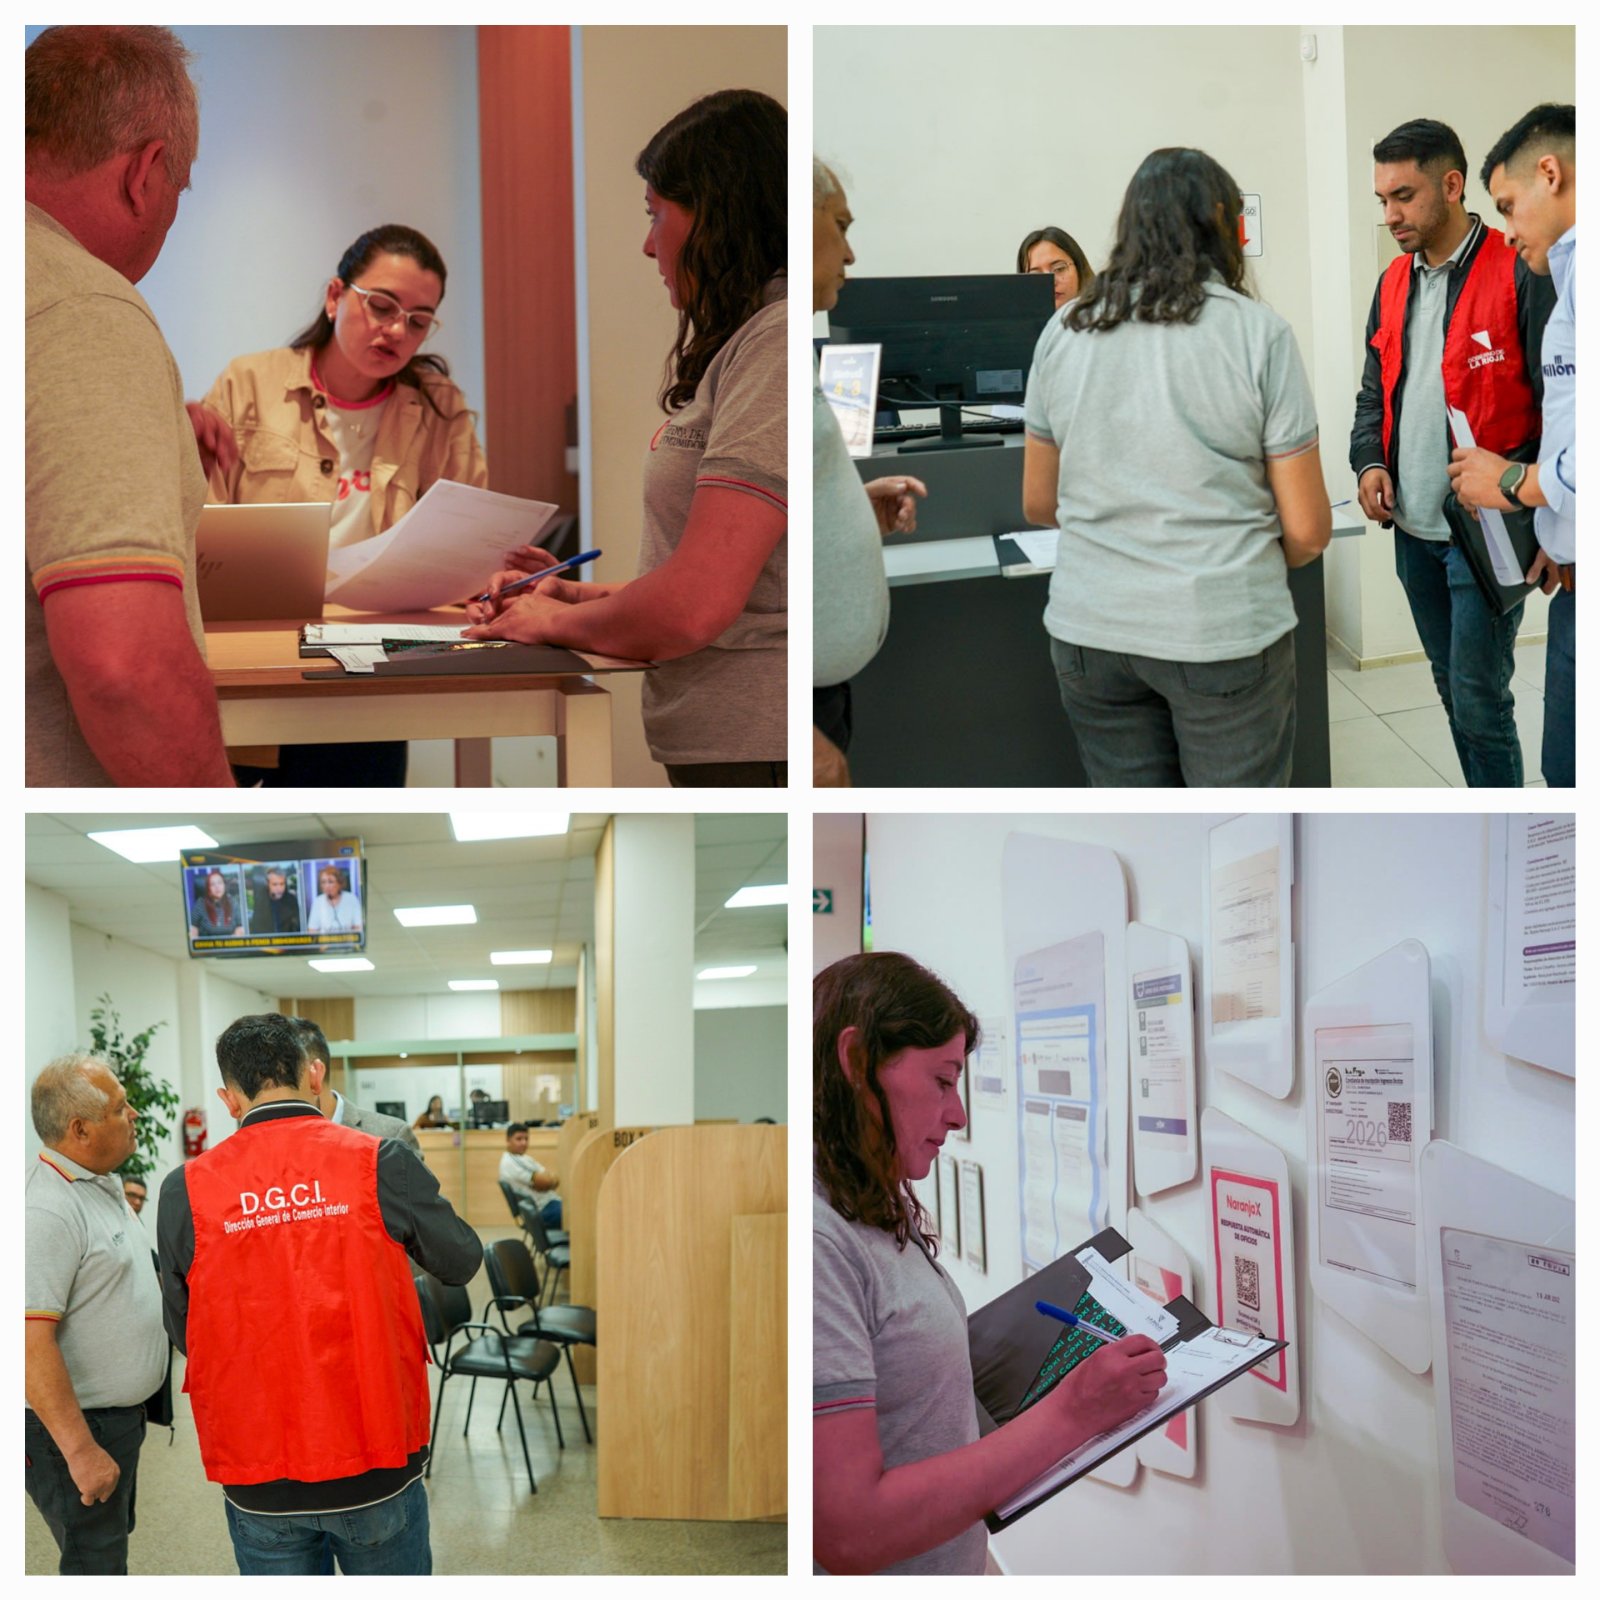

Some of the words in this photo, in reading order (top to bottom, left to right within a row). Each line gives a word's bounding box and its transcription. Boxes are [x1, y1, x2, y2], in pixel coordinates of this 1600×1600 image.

[1468, 360, 1481, 370] LA
[1481, 354, 1505, 366] RIOJA
[1346, 1119, 1388, 1148] 2026
[239, 1180, 326, 1216] D.G.C.I.
[223, 1216, 256, 1234] Dirección
[255, 1212, 281, 1228] General
[281, 1210, 291, 1222] de
[292, 1206, 323, 1222] Comercio
[1220, 1218, 1244, 1231] RESPUESTA
[1243, 1225, 1271, 1240] AUTOMÁTICA
[1234, 1232, 1241, 1241] DE
[1240, 1234, 1258, 1246] OFICIOS
